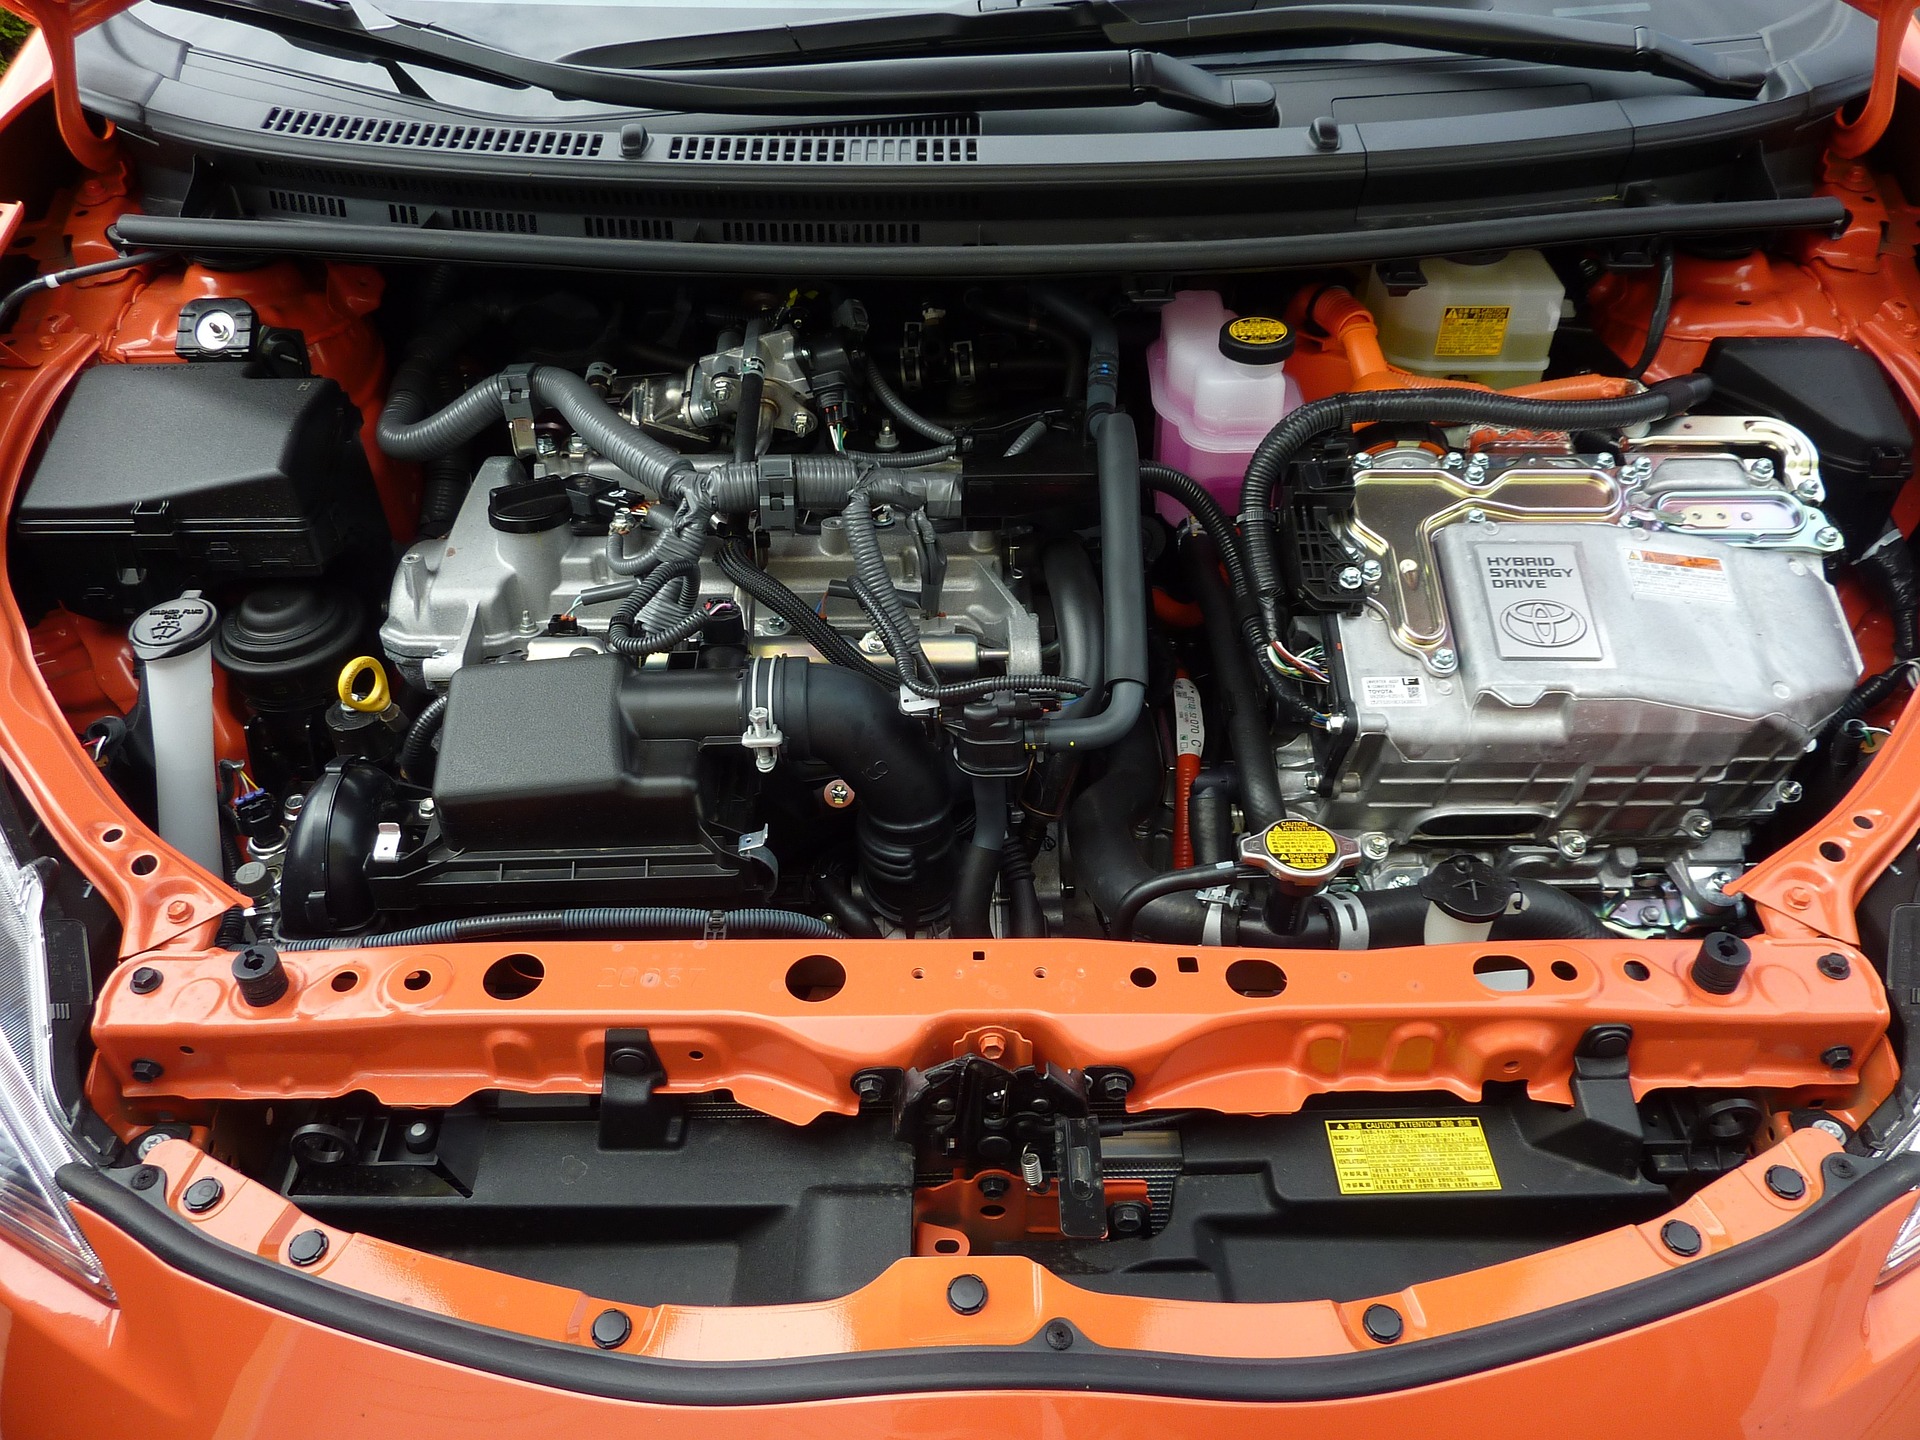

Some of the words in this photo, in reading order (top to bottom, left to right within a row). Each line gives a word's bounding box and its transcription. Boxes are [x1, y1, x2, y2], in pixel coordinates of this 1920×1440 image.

[1486, 556, 1555, 567] HYBRID
[1489, 568, 1574, 578] SYNERGY
[1492, 579, 1547, 589] DRIVE
